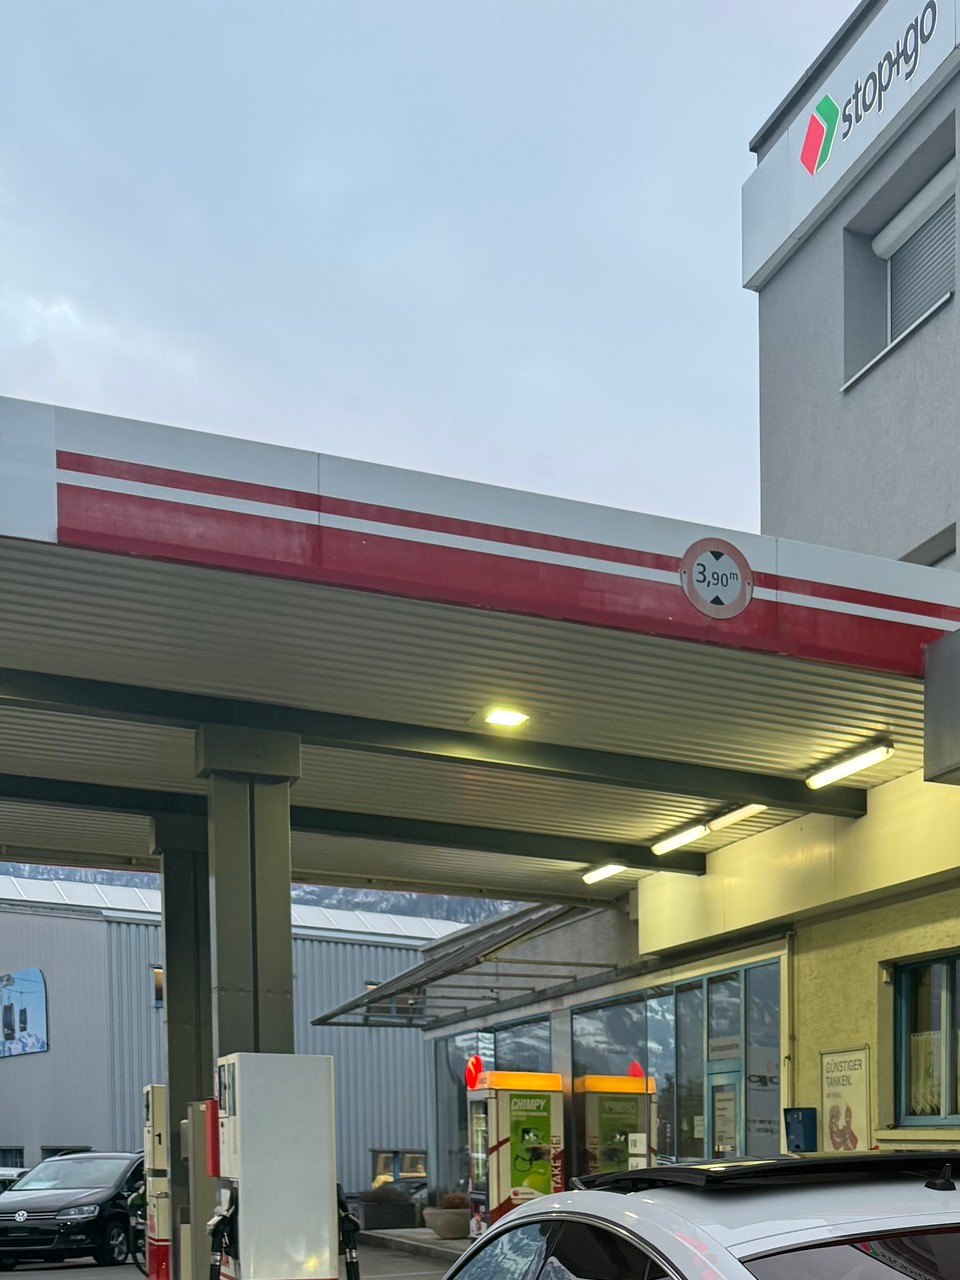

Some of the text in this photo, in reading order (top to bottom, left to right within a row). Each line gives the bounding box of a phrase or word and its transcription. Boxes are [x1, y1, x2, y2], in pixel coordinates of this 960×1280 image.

[842, 0, 937, 140] stop+go
[826, 1059, 863, 1073] GÜNSTIGER
[511, 1098, 545, 1110] CHIMPY
[551, 1135, 562, 1188] TAKE ME!
